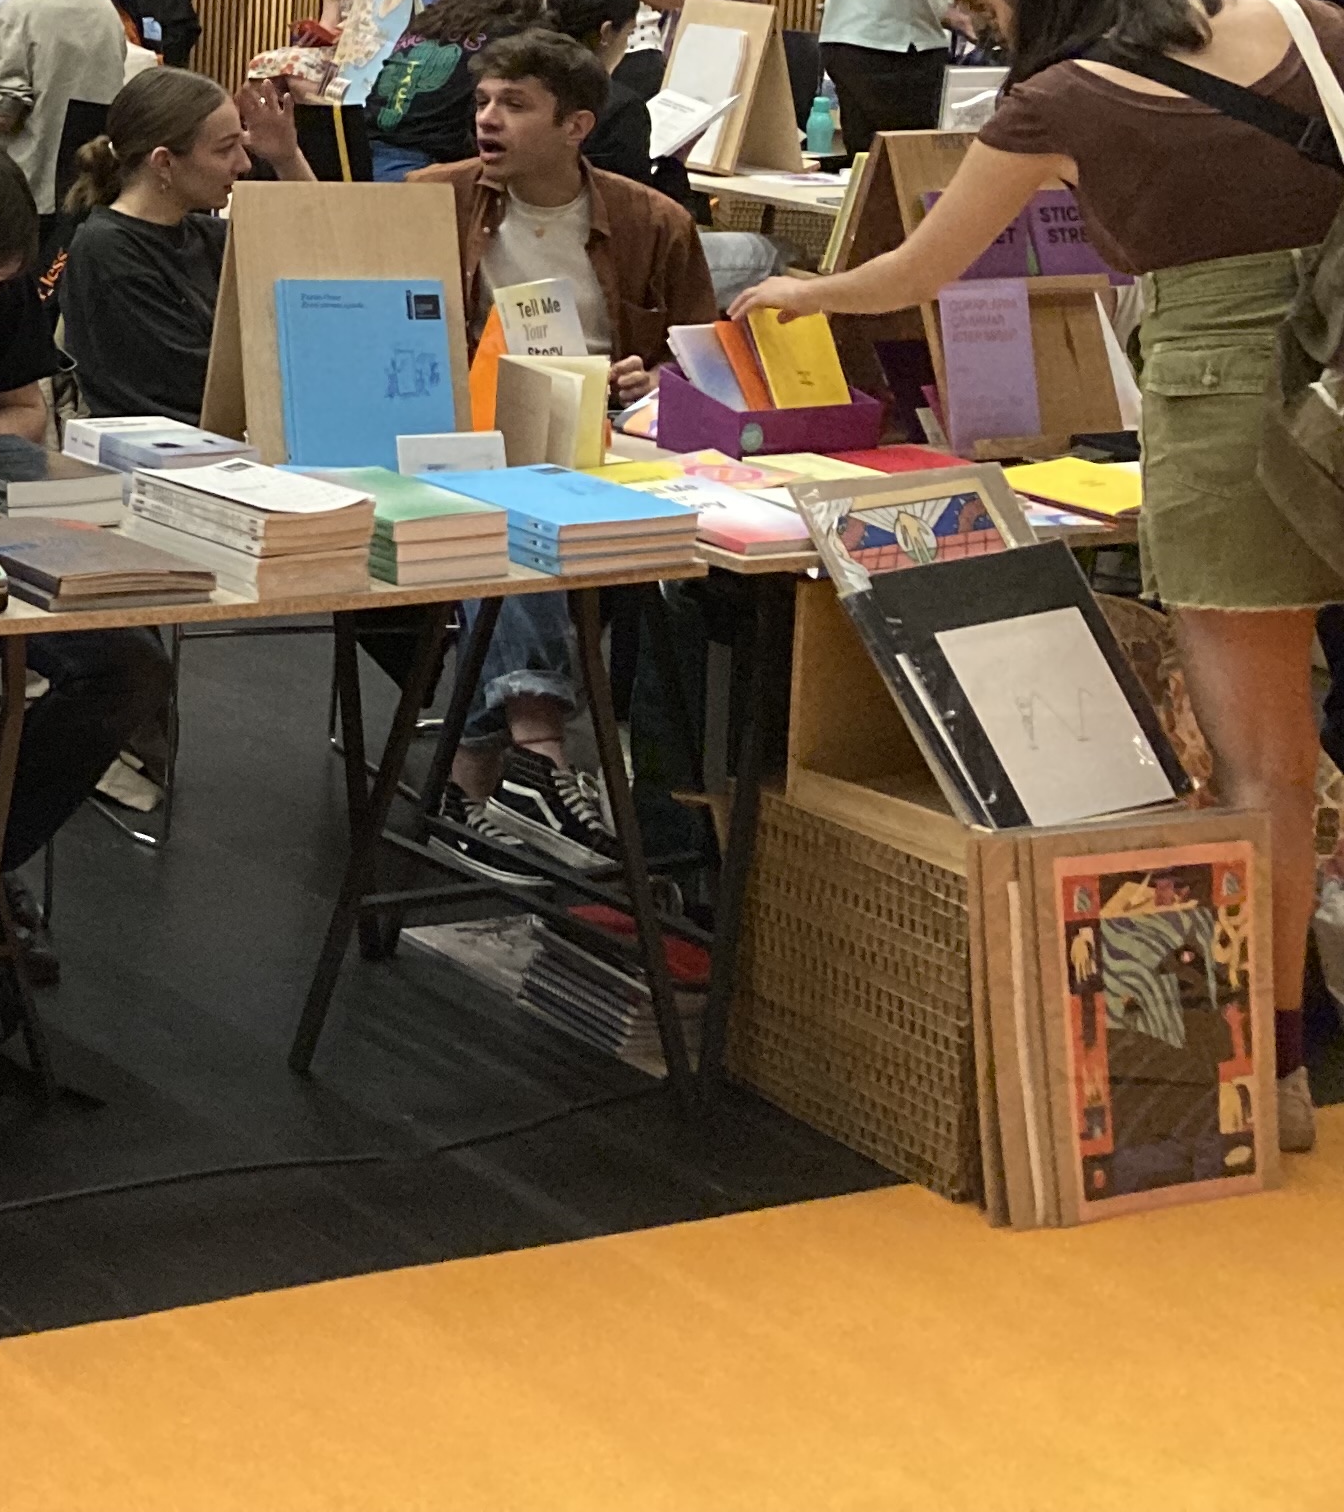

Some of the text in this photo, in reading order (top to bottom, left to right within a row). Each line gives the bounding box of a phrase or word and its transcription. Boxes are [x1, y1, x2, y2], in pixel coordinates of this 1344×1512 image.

[516, 296, 562, 319] Tell Me
[523, 323, 549, 341] Your
